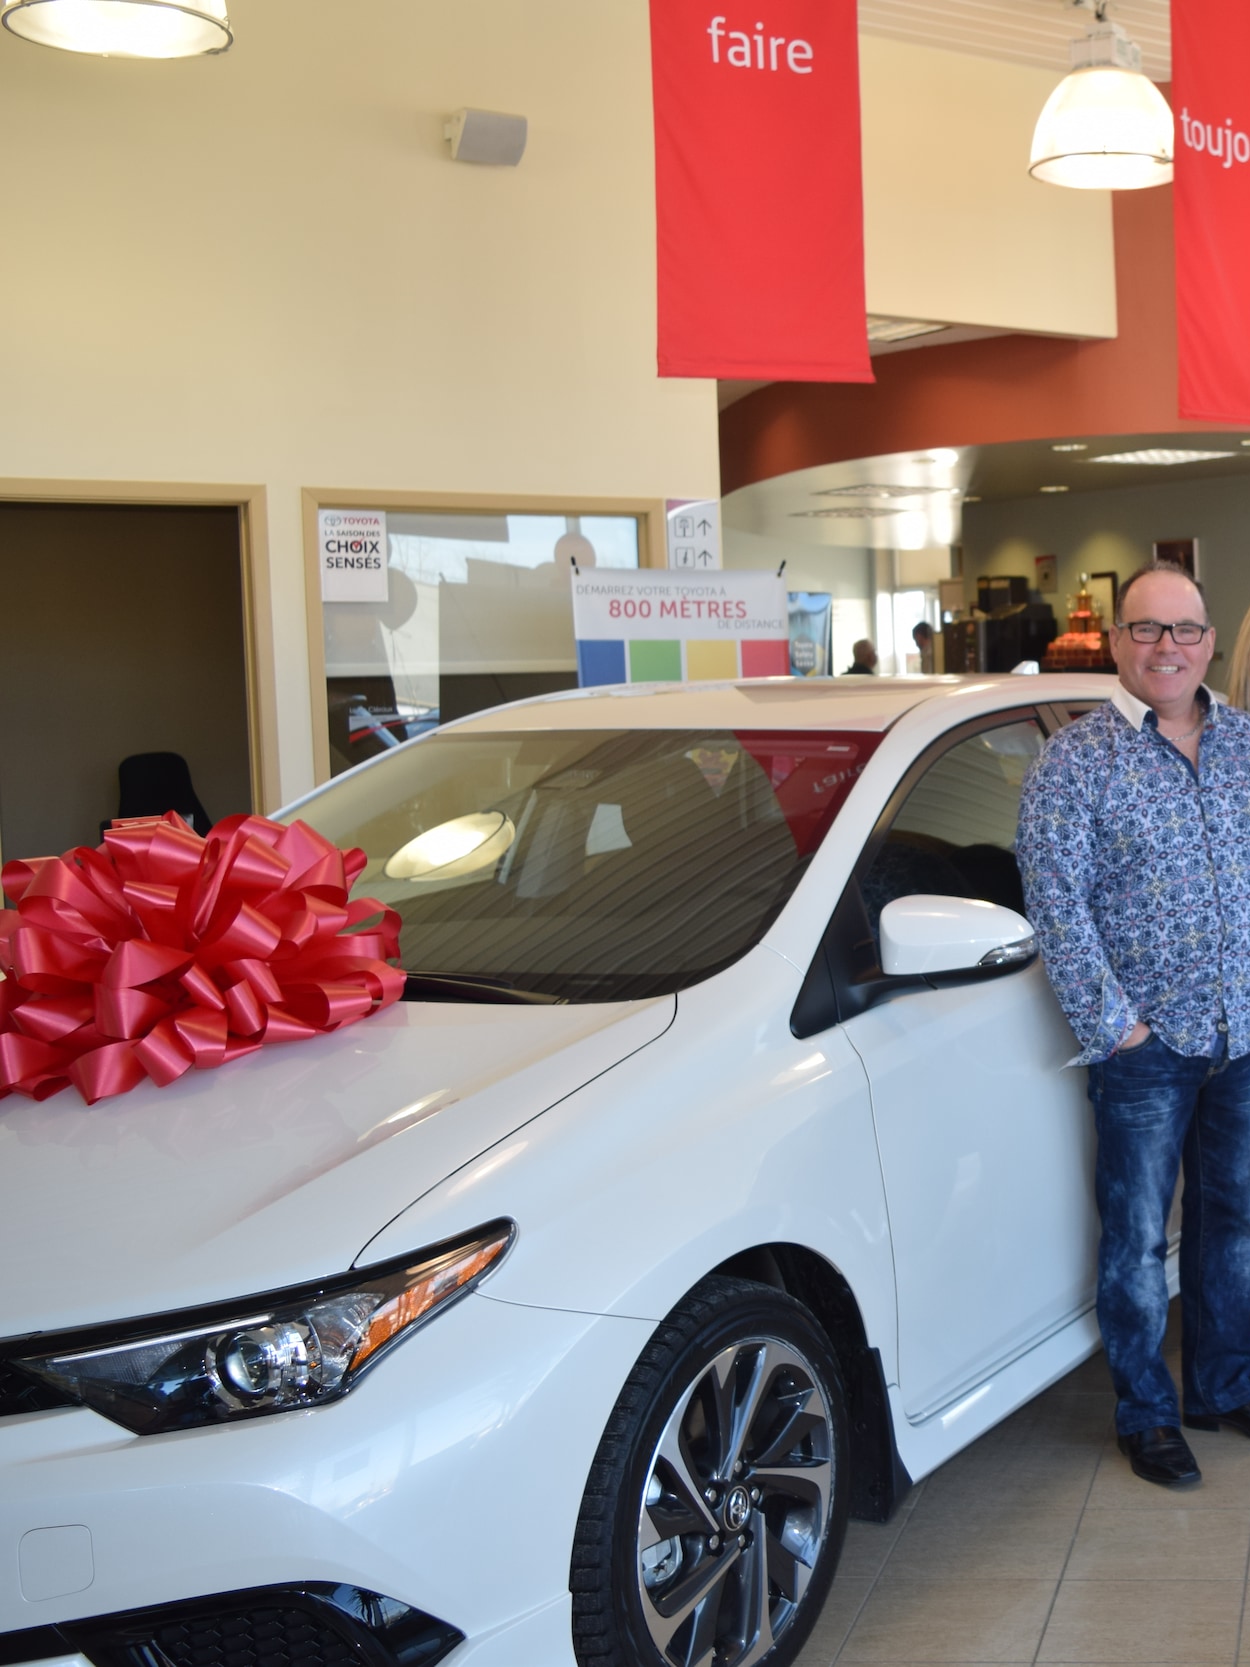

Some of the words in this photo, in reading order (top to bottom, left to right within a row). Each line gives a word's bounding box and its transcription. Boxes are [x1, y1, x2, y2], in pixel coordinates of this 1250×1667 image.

[706, 16, 814, 74] faire
[343, 516, 380, 525] TOYOTA
[336, 529, 365, 537] SAISON
[325, 539, 380, 554] CHOIX
[326, 553, 382, 569] SENSÉS
[576, 584, 634, 596] DÉMARREZ
[636, 585, 672, 596] VOTRE
[675, 586, 716, 597] TOYOTA
[608, 599, 652, 619] 800
[659, 595, 748, 619] MÈTRES
[717, 619, 731, 630] DE
[734, 619, 785, 630] DISTANCE
